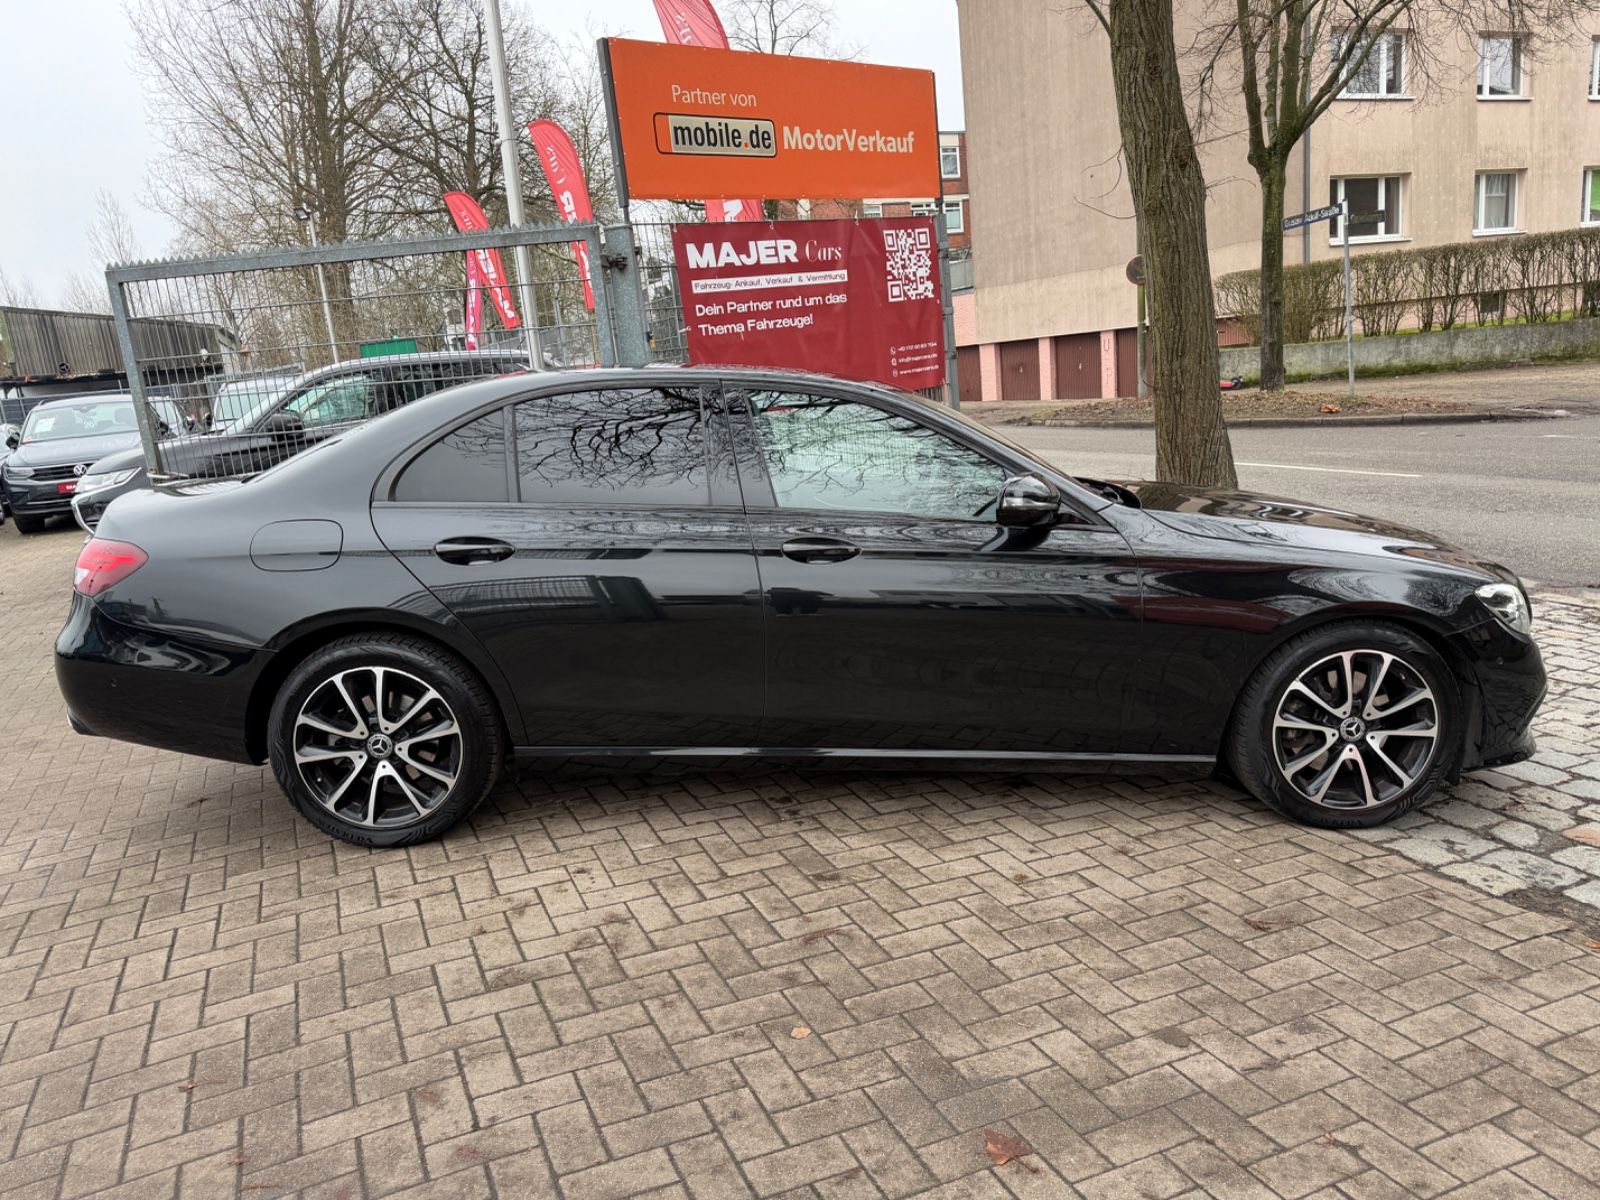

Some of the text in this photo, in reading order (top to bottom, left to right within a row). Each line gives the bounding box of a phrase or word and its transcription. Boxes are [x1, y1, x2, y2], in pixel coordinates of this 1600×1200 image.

[671, 84, 757, 107] Partner von
[673, 121, 914, 153] mobile.de MotorVerkauf
[685, 239, 842, 269] MAJER Cars
[765, 276, 793, 285] Verkauf
[806, 272, 846, 282] Vermittlung
[695, 292, 847, 317] Dein Partner rund um das
[698, 313, 814, 337] Thema Fahrzeuge!
